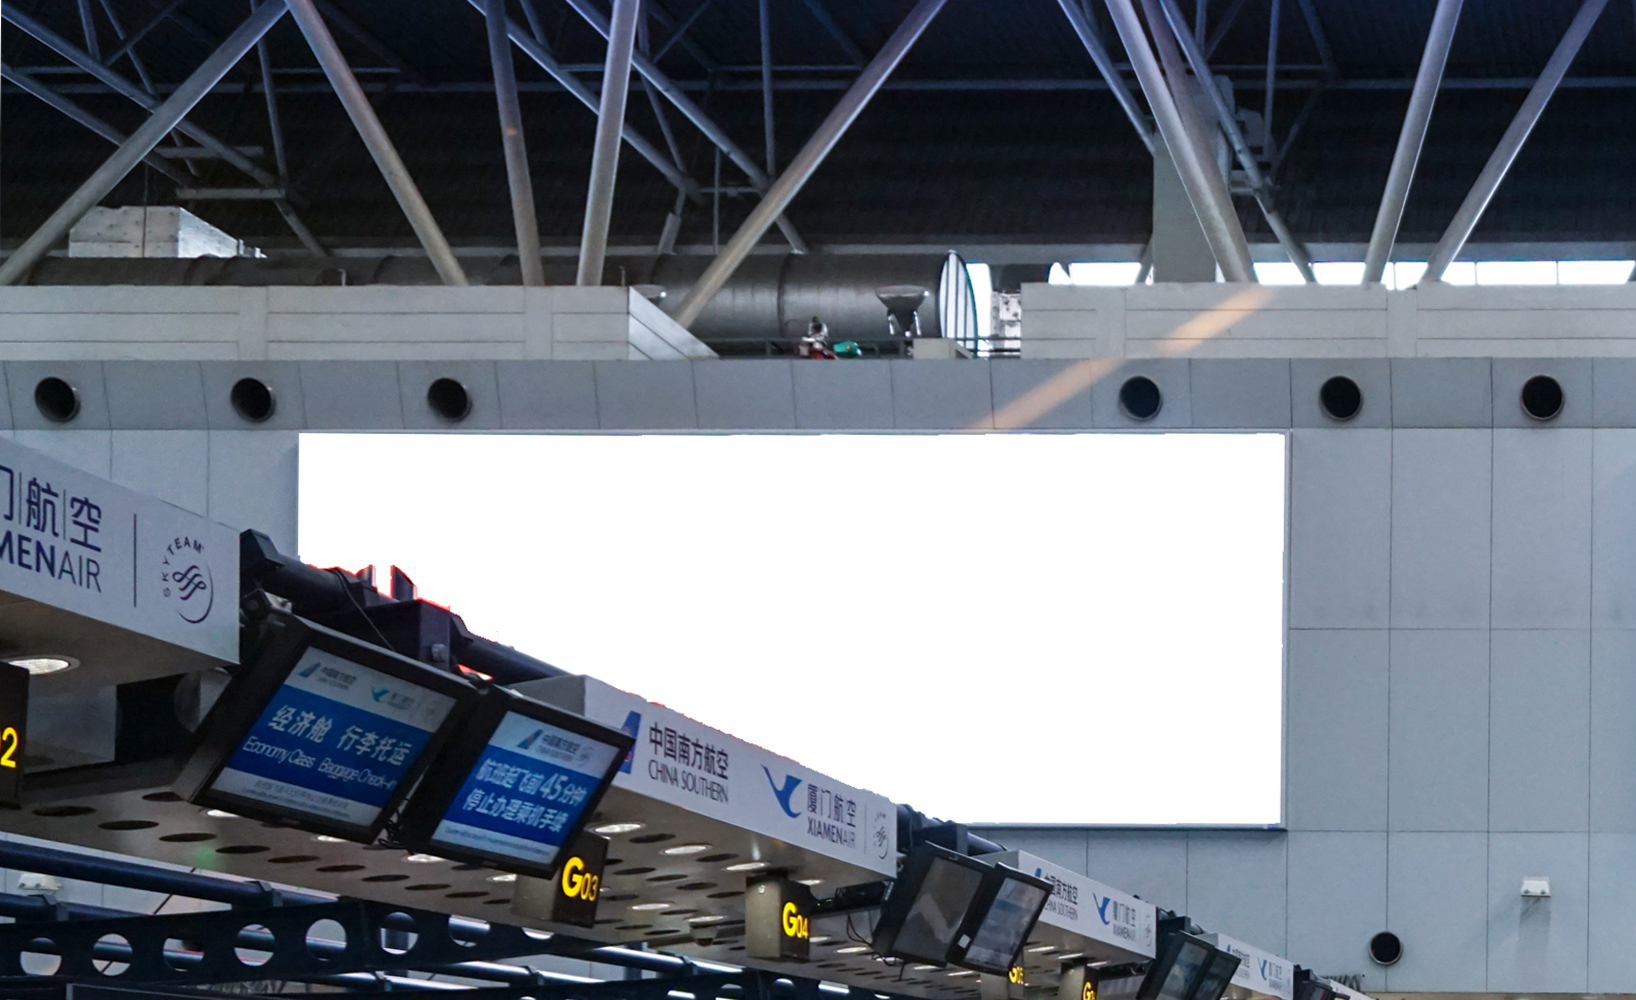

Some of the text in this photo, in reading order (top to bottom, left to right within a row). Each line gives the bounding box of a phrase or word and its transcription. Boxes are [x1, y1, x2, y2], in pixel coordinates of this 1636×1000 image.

[242, 736, 288, 764] Economy
[268, 704, 412, 766] 经济舱 行李托运
[649, 721, 729, 780] 中国南方航空
[648, 759, 729, 804] CHINA SOUTHERN
[807, 784, 856, 828] 厦门航空
[807, 818, 856, 850] XIAMENAIR
[562, 856, 598, 902] G03
[783, 902, 808, 939] G04
